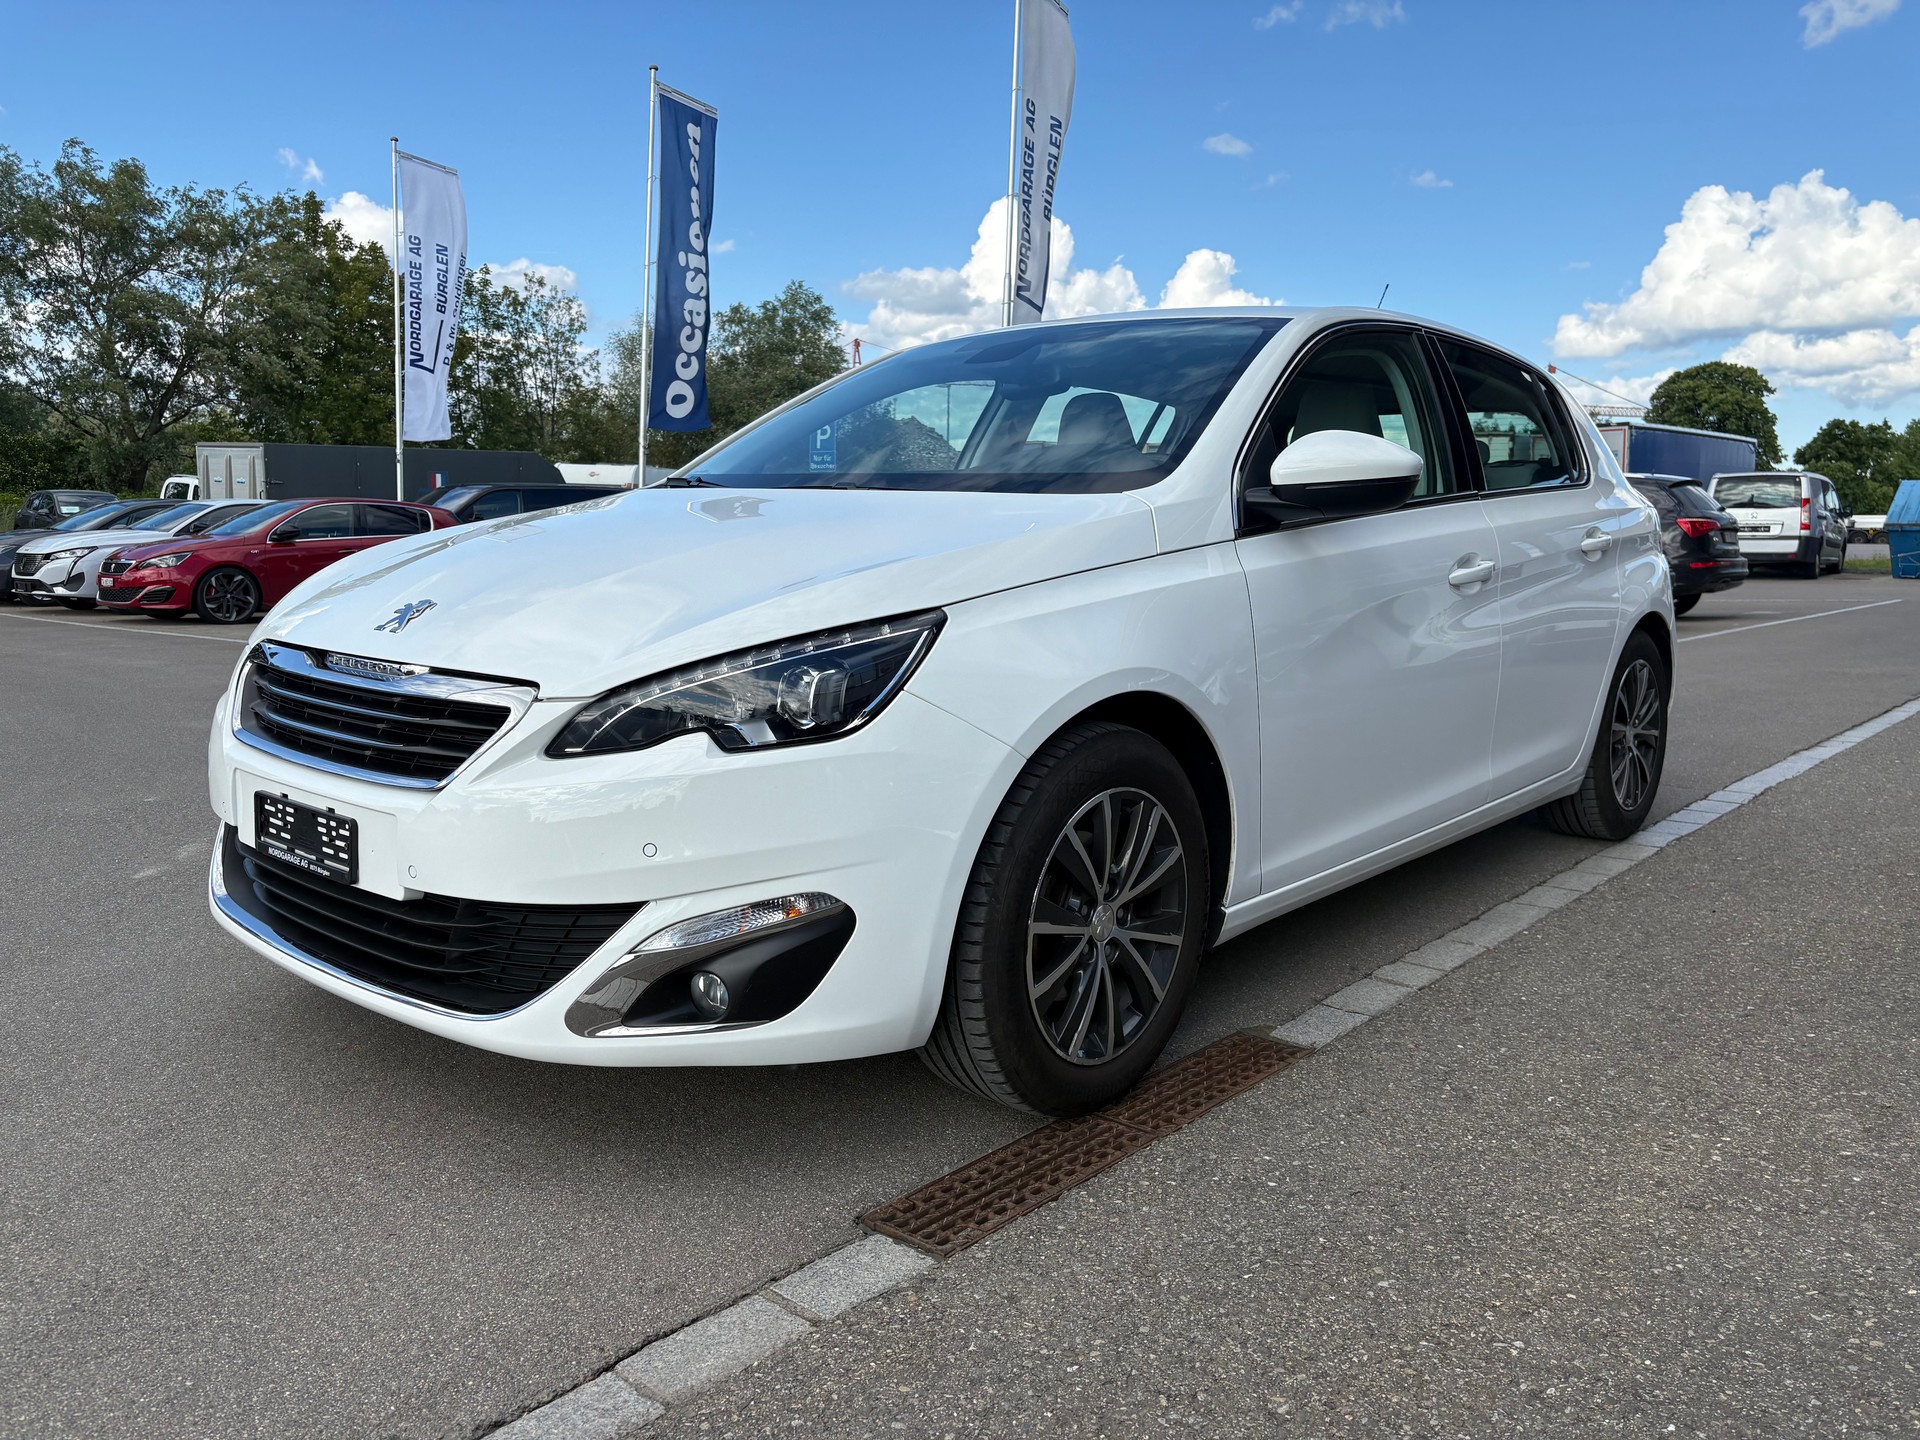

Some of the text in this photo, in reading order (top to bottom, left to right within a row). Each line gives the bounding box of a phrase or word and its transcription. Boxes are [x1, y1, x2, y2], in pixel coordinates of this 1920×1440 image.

[1016, 98, 1038, 308] NORDGARAGE AG
[1041, 115, 1063, 223] BÜRGLEN
[408, 234, 430, 371] NORDGARAGE AG
[435, 243, 449, 315] BÜRGLEN
[666, 122, 707, 419] Occasionen
[816, 425, 831, 449] P
[333, 655, 393, 674] PEUGEOT
[268, 846, 301, 866] NORDGARAGE
[300, 858, 309, 868] AG
